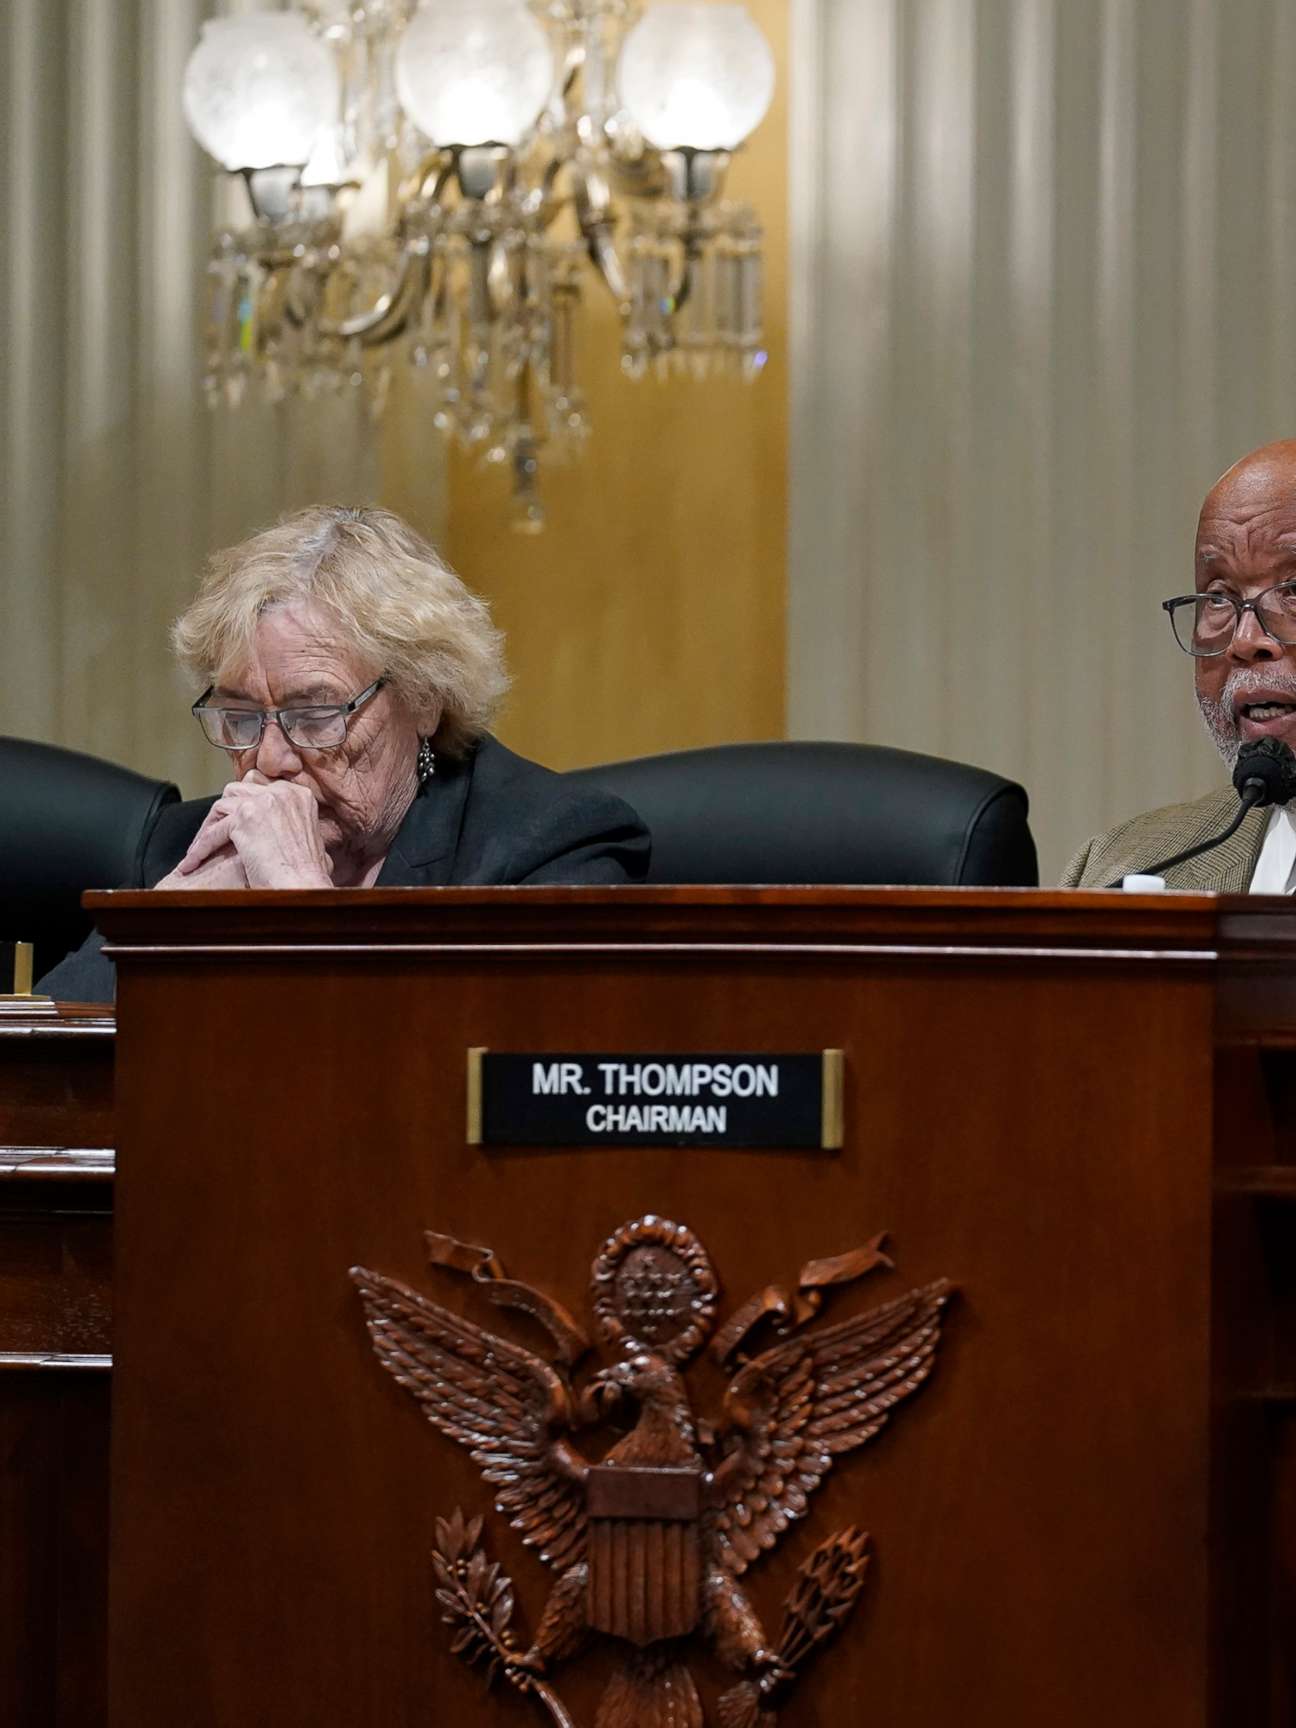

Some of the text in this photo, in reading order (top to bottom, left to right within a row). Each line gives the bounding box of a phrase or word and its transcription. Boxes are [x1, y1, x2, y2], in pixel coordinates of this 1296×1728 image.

[532, 1062, 779, 1097] MR. THOMPSON
[586, 1104, 727, 1133] CHAIRMAN
